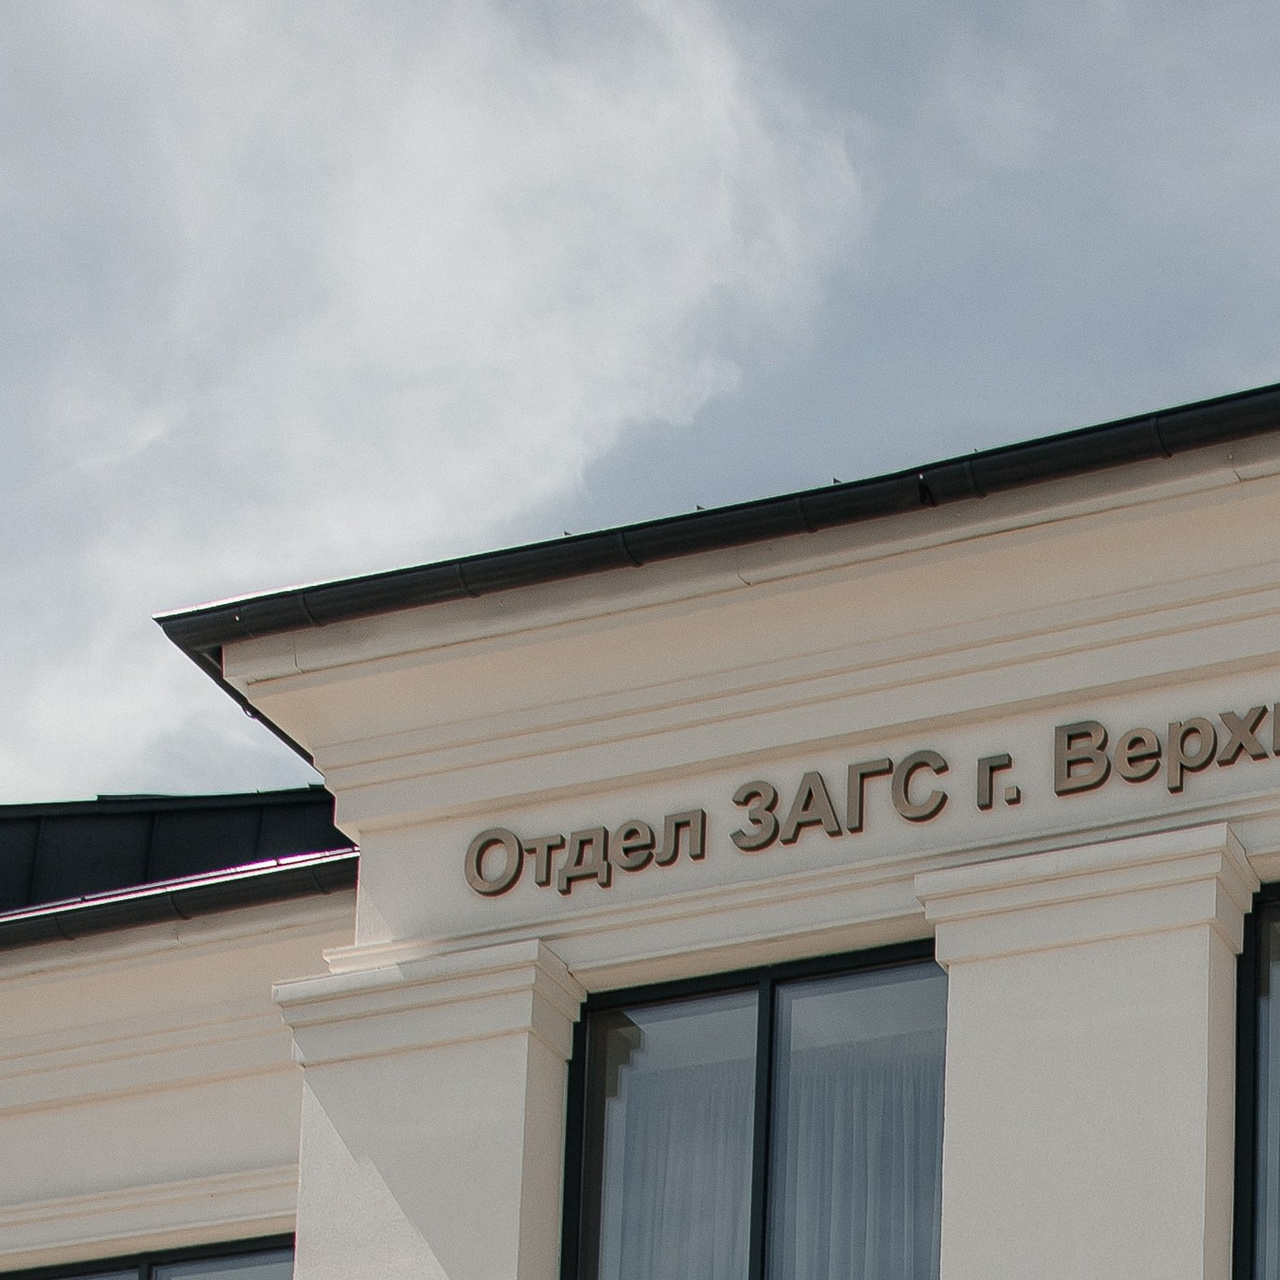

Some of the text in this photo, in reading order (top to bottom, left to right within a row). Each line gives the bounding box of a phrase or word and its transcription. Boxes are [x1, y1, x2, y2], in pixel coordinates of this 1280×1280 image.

[463, 826, 706, 896] Отдел
[730, 749, 949, 852] ЗАГС
[976, 752, 1021, 811] г.
